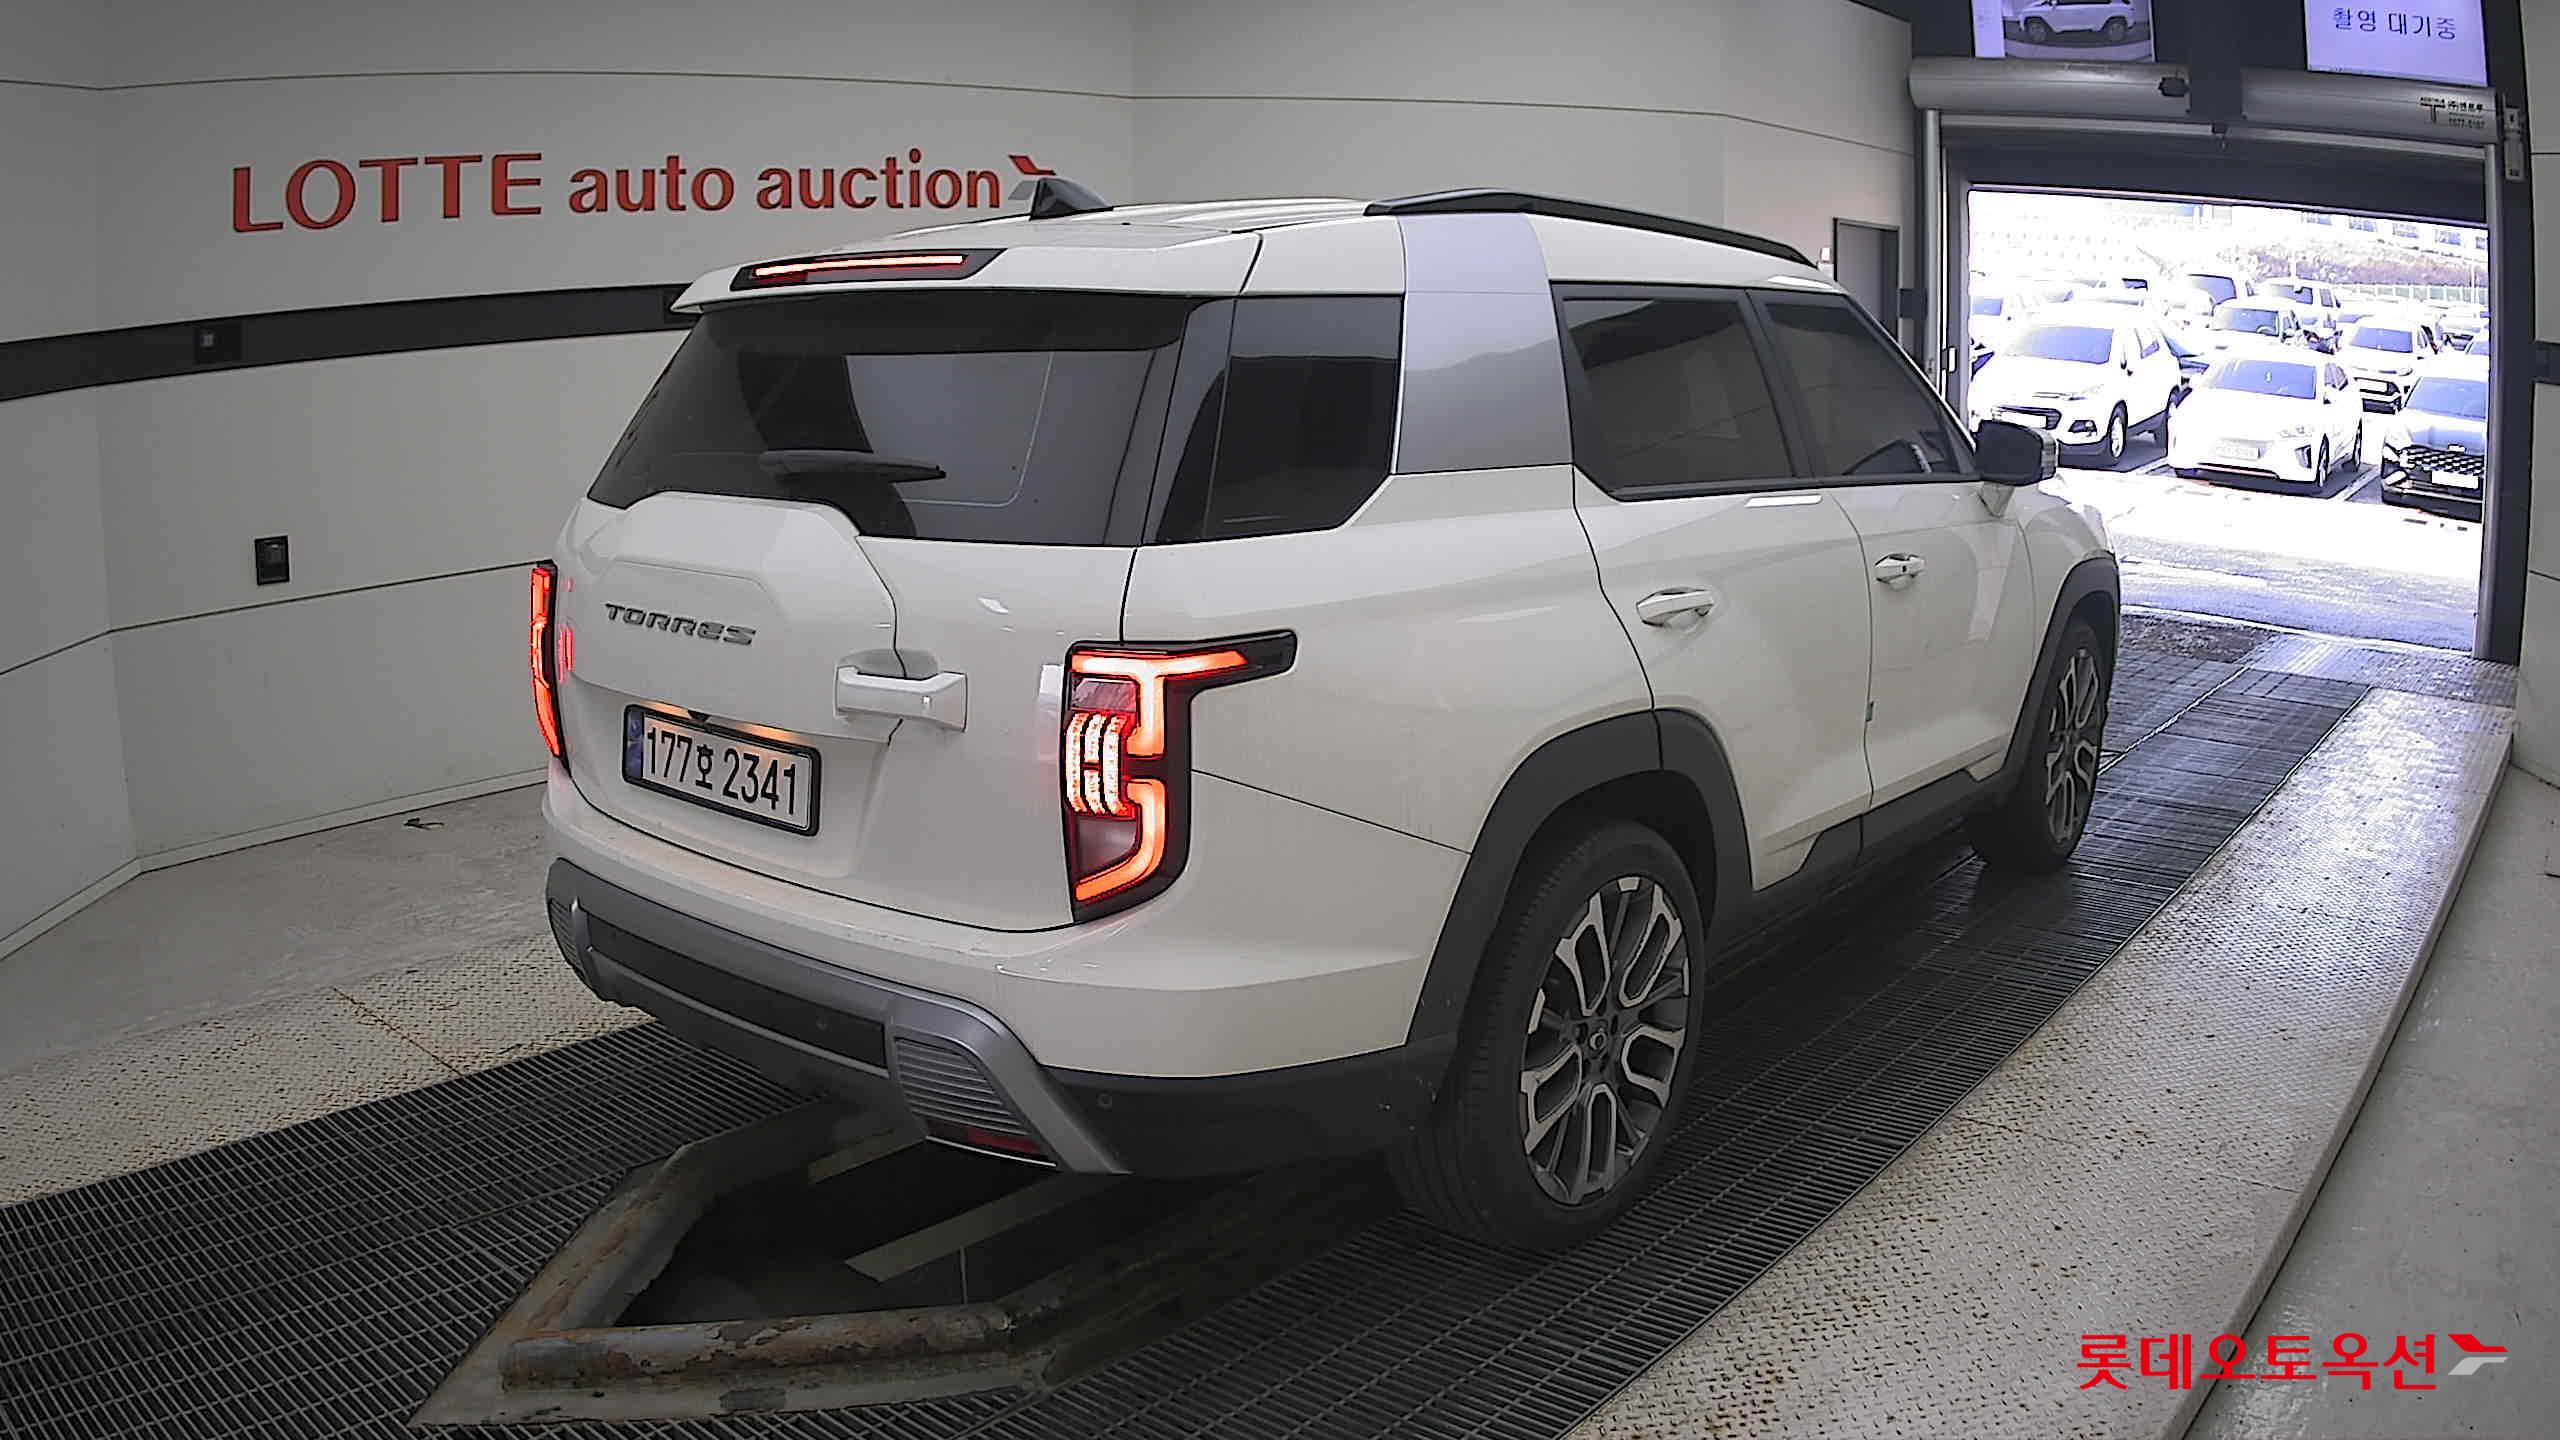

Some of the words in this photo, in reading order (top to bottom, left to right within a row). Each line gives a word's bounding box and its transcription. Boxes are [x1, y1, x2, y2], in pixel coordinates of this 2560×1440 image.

[2333, 7, 2377, 32] 촬영
[2388, 12, 2457, 40] 대기중
[233, 152, 543, 233] LOTTE
[568, 155, 735, 213] auto
[757, 148, 1002, 210] auction
[604, 602, 757, 646] TORRES
[722, 747, 797, 815] 2341
